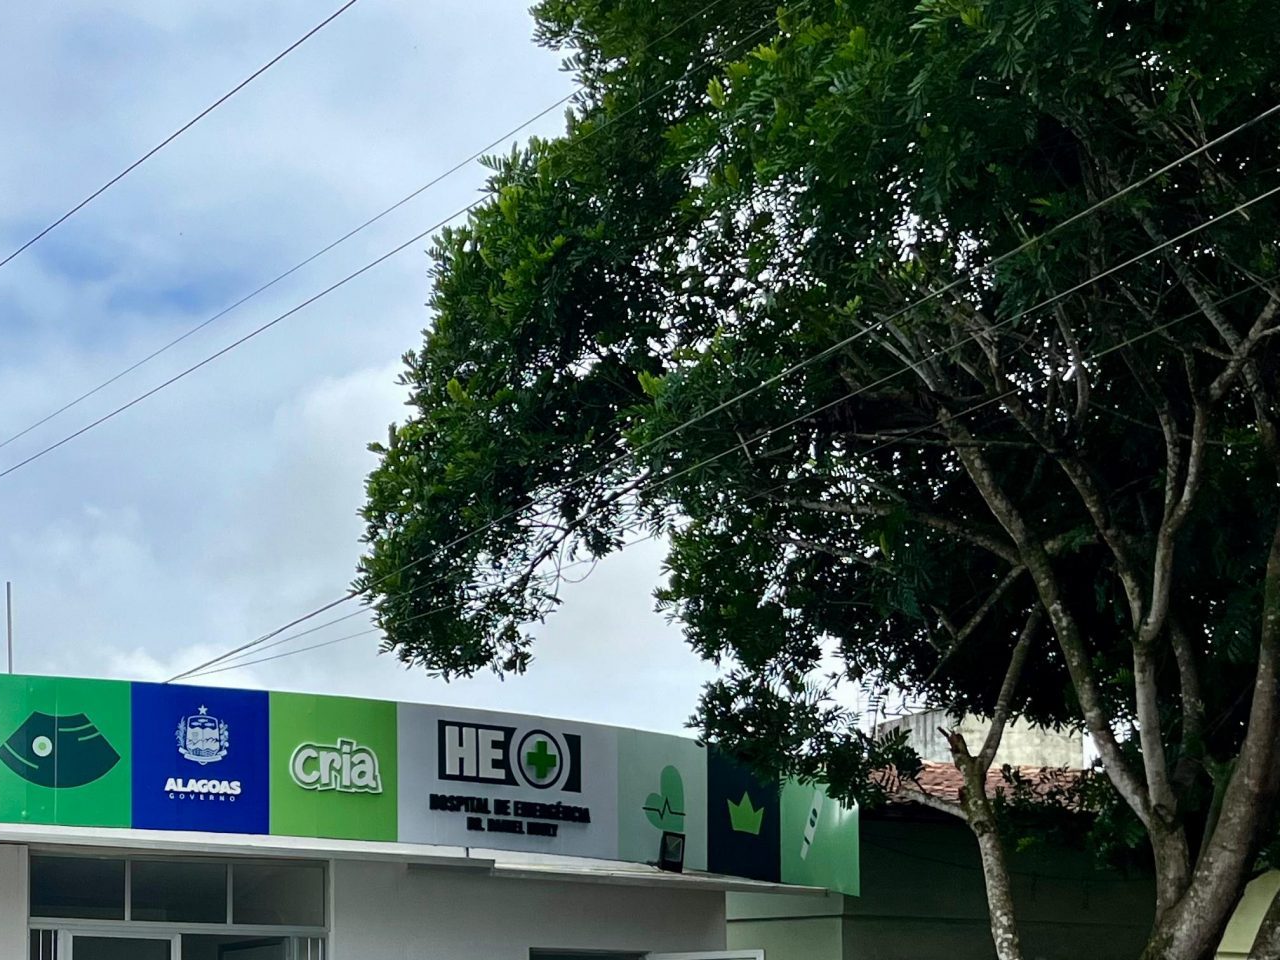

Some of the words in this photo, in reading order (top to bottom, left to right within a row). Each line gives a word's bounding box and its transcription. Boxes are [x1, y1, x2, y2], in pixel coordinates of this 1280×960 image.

[293, 743, 378, 789] cria
[164, 777, 242, 795] ALAGOAS
[168, 792, 236, 803] GOVERNO
